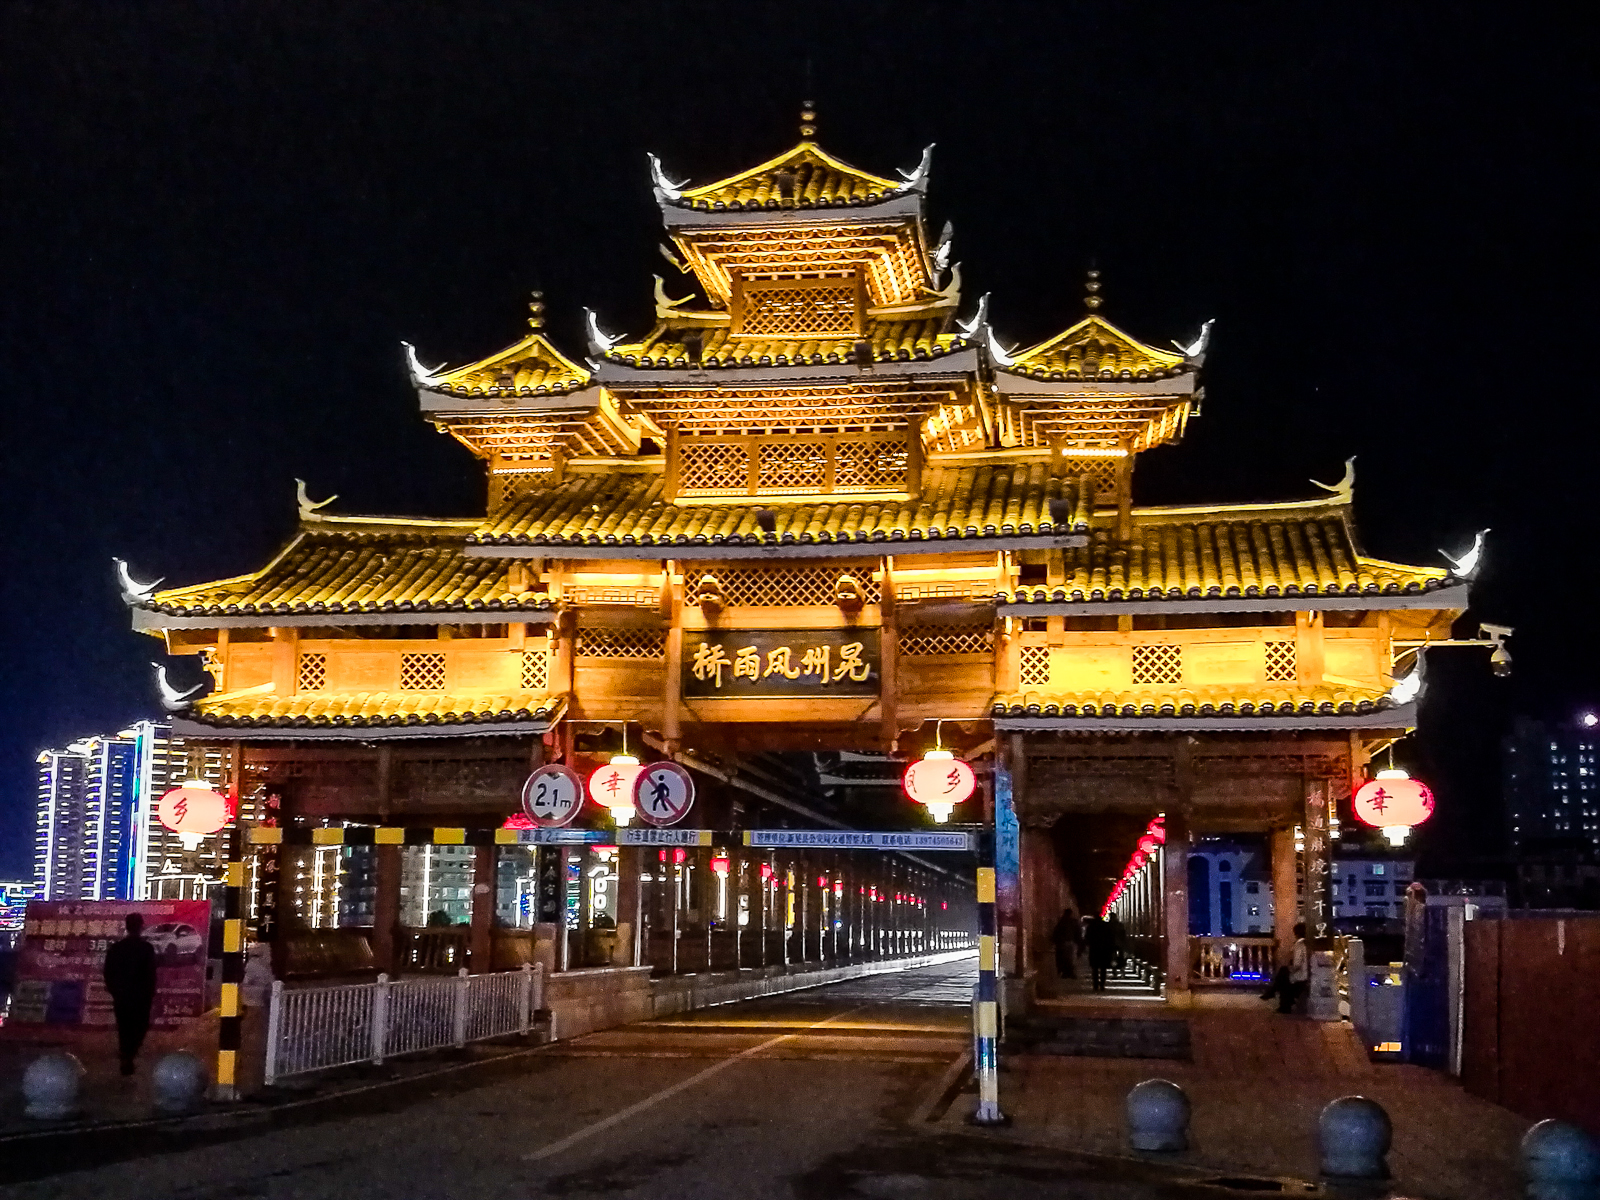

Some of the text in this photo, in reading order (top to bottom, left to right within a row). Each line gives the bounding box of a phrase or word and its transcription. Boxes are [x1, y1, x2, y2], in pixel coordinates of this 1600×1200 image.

[942, 767, 961, 795] 乡
[535, 783, 572, 808] 2.1m
[173, 797, 188, 825] 乡
